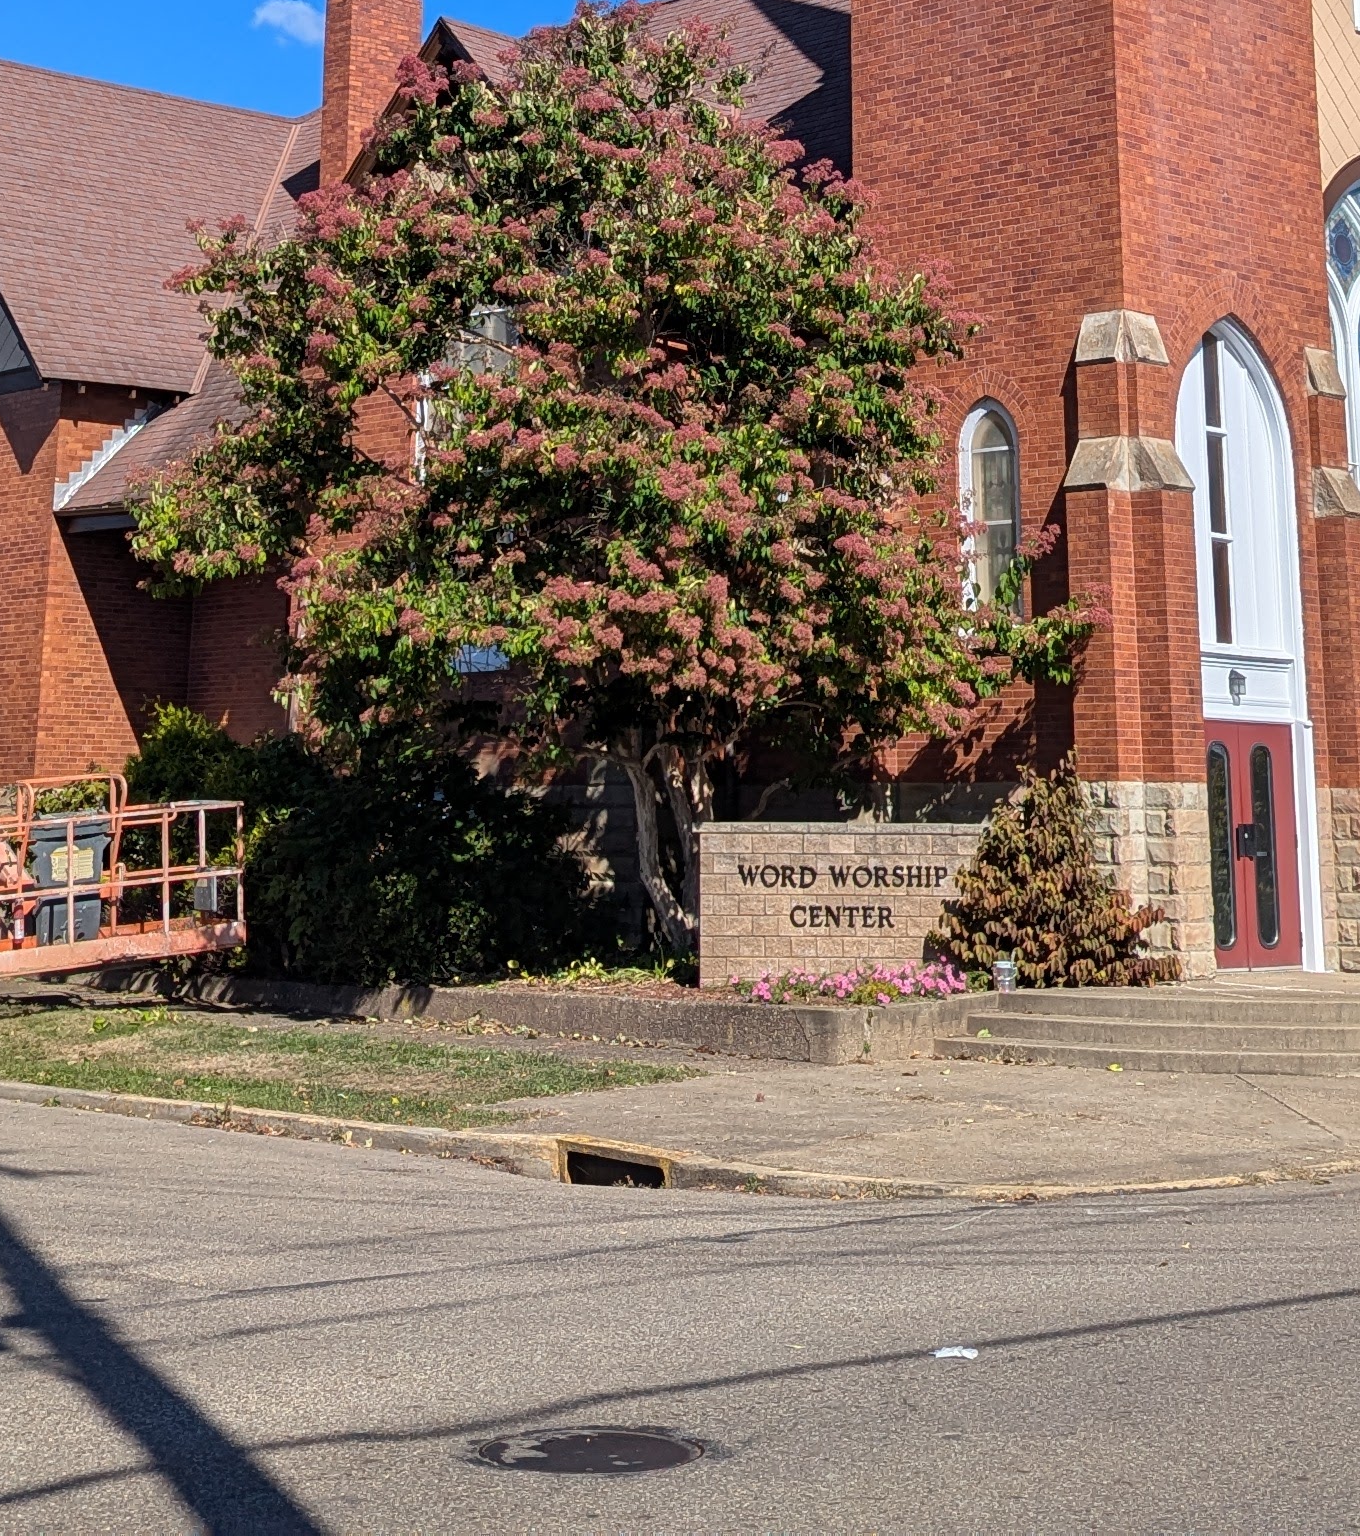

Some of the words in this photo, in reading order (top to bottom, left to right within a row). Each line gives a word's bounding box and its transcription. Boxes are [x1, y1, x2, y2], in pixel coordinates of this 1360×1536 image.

[737, 864, 817, 888] WORD
[828, 865, 948, 888] WORSHIP
[789, 904, 895, 928] CENTER
